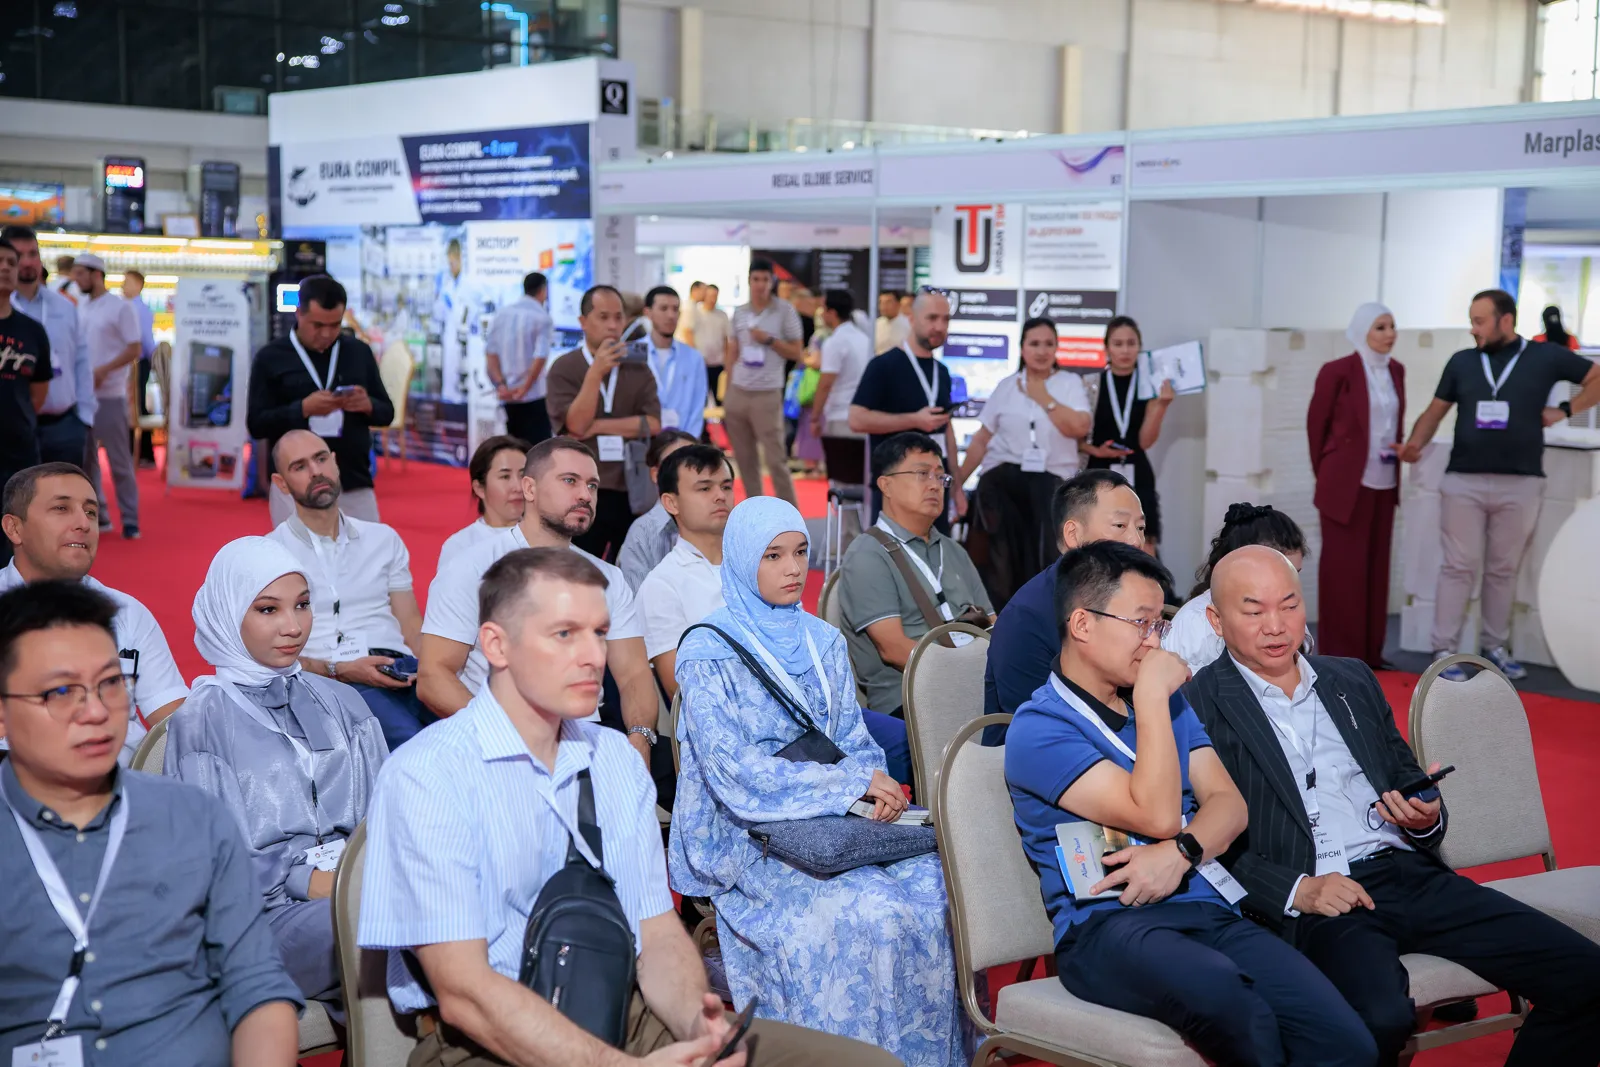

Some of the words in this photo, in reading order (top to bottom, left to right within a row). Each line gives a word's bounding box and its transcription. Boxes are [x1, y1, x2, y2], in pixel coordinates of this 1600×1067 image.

[319, 161, 351, 180] EURA
[354, 159, 402, 178] COMPIL
[834, 168, 874, 186] SERVICE
